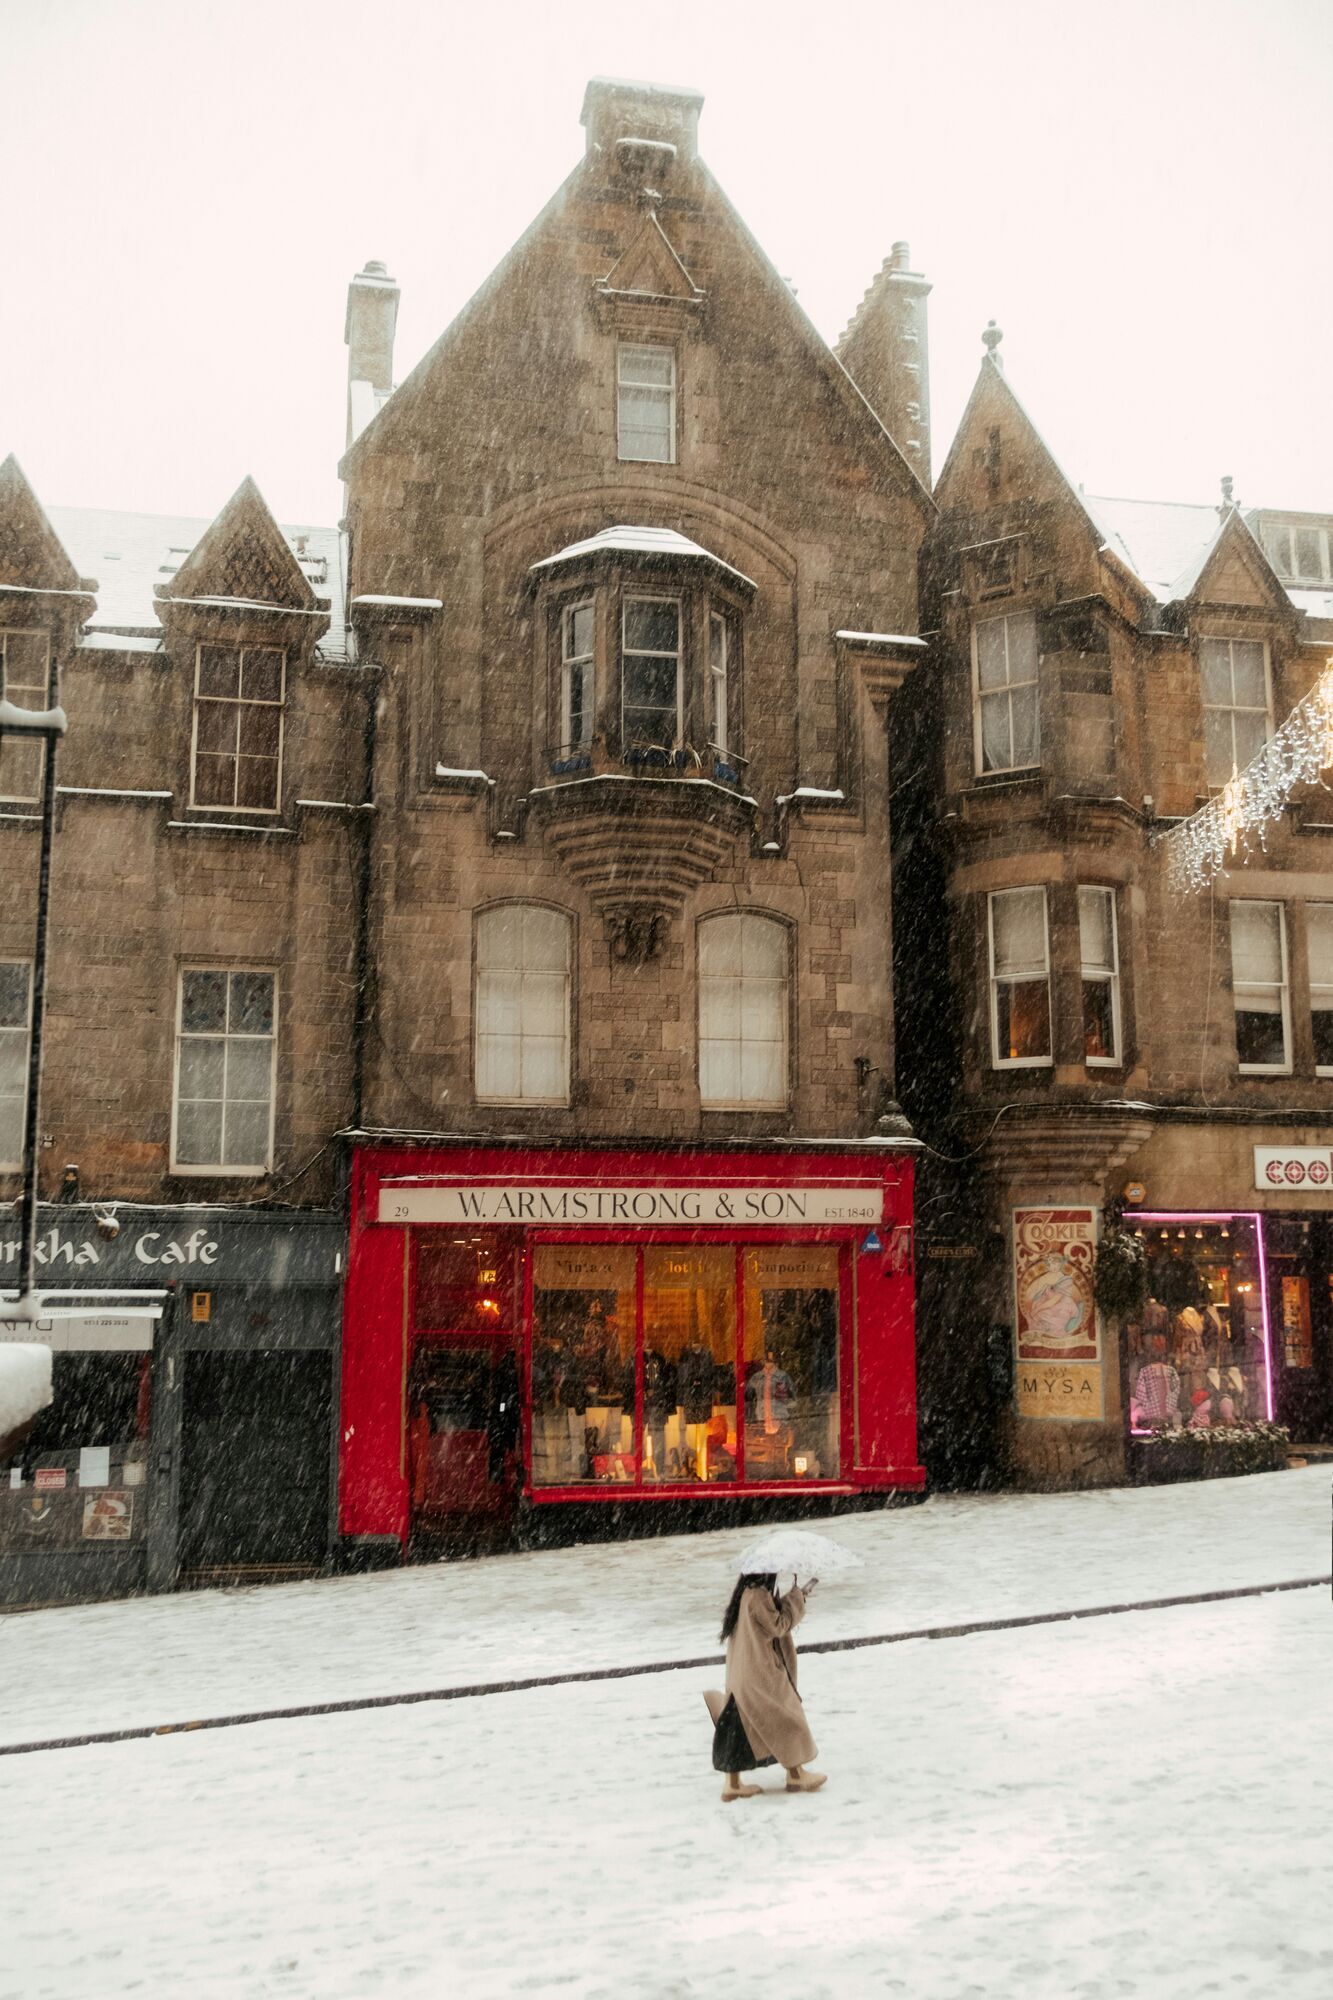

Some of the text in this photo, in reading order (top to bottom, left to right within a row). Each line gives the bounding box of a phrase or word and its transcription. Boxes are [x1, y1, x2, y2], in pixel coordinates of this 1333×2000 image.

[394, 1206, 409, 1217] 29
[493, 1191, 701, 1219] ARMSTRONG
[715, 1192, 735, 1219] &
[745, 1192, 806, 1219] SON
[848, 1207, 875, 1218] 1840
[0, 1228, 219, 1265] rkha Cafe
[557, 1260, 614, 1276] Vintae
[1023, 1378, 1093, 1394] MYSA
